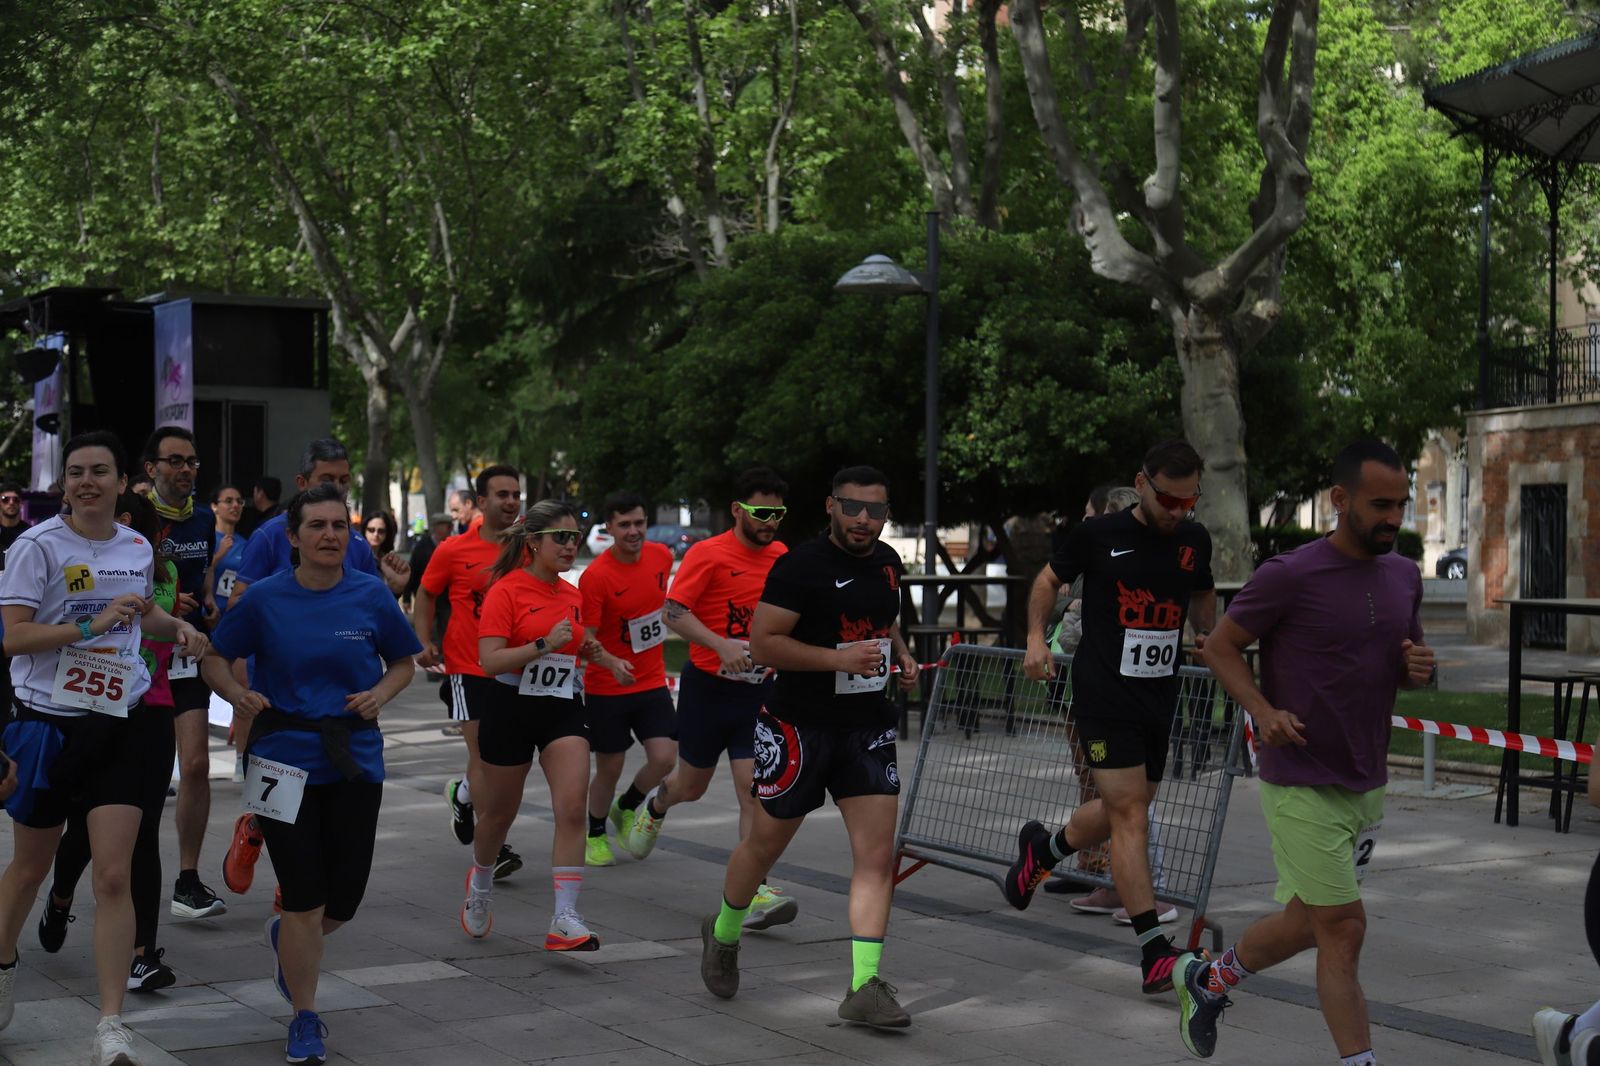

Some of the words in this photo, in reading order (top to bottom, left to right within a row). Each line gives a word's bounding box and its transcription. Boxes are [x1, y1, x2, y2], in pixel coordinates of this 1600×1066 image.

[1118, 602, 1184, 629] CLUB
[640, 620, 661, 641] 85
[66, 650, 77, 658] DÍA
[97, 657, 132, 671] COMUNIDAD
[1131, 644, 1173, 666] 190
[74, 659, 102, 670] CASTILLA
[108, 667, 122, 676] LEÓN
[529, 665, 570, 688] 107
[63, 667, 123, 701] 255
[261, 763, 284, 775] CASTILLA
[260, 775, 278, 802] 7
[758, 784, 781, 794] MMA
